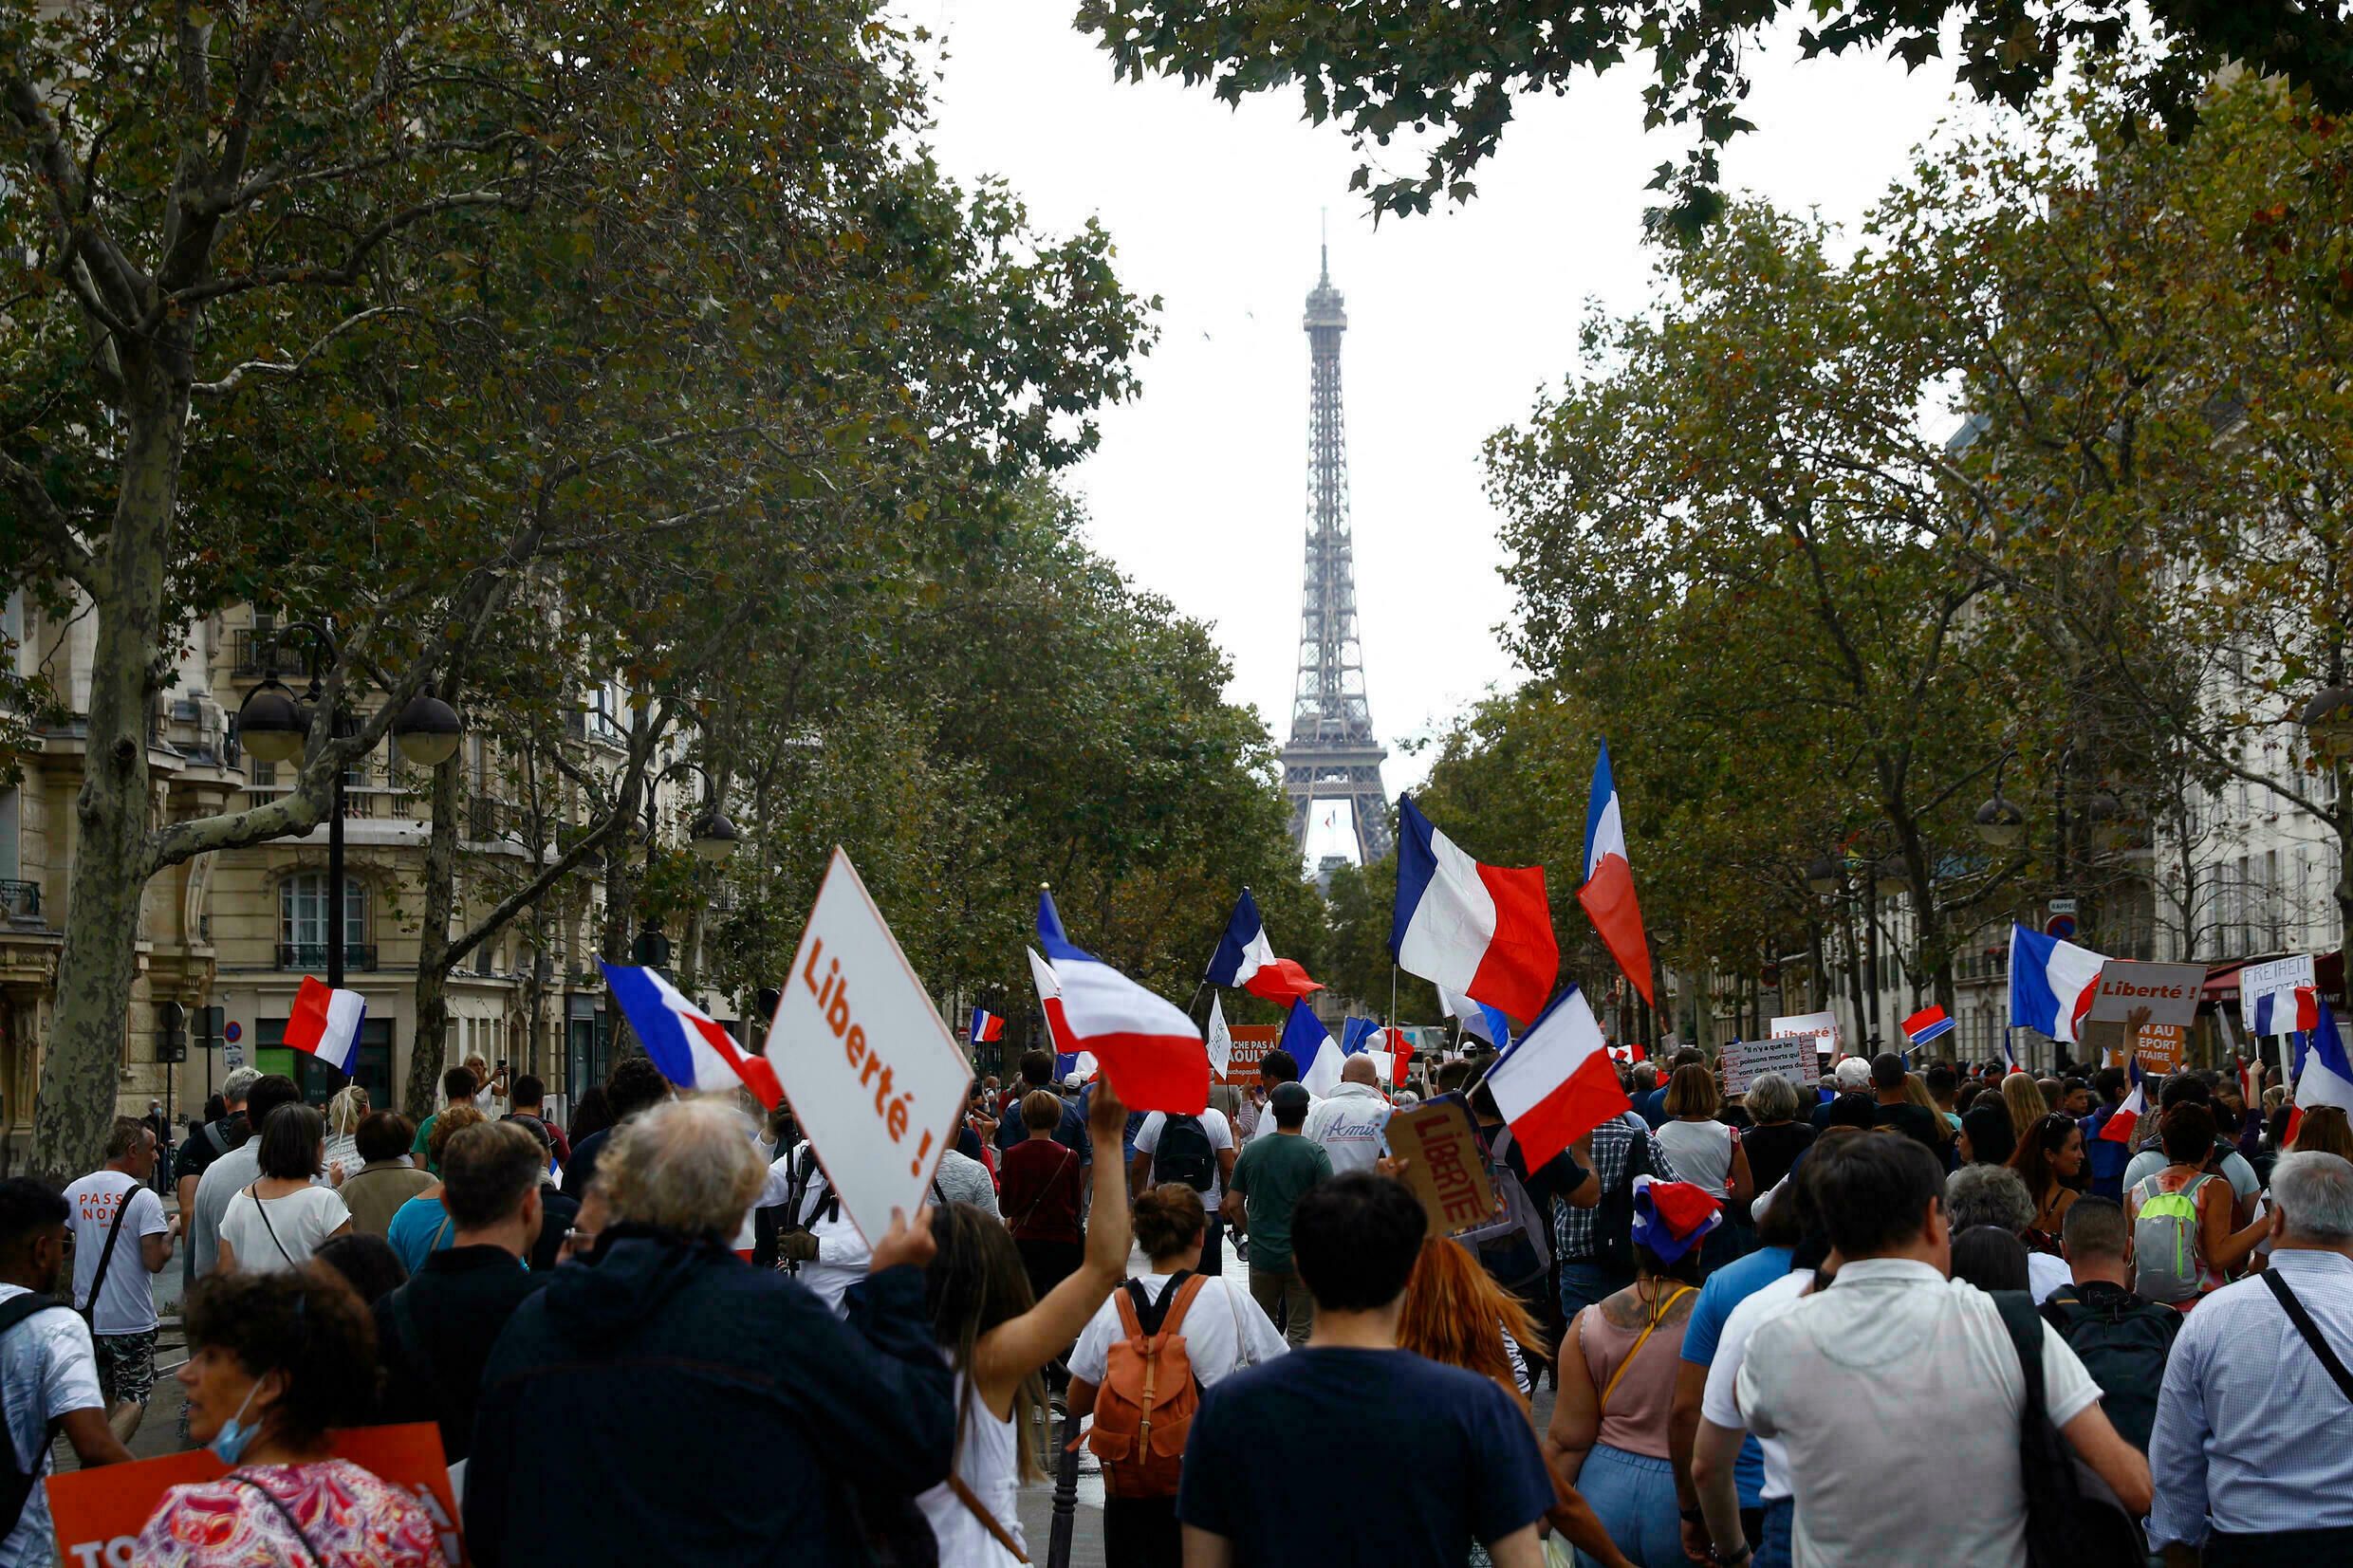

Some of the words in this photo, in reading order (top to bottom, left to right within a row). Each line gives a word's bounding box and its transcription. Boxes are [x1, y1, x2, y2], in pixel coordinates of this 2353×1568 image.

[2244, 955, 2309, 985] FREIHEIT
[2102, 980, 2182, 999] Liberté
[2188, 987, 2196, 1000] !
[2154, 1024, 2175, 1037] AU
[804, 936, 914, 1143] Liberté
[1251, 1040, 1268, 1049] PAS
[1269, 1039, 1276, 1049] À
[1769, 1043, 1783, 1052] que
[1229, 1049, 1269, 1062] AOULT
[1738, 1057, 1768, 1067] poissons
[1327, 1112, 1375, 1137] Amis
[79, 1192, 122, 1206] PASS
